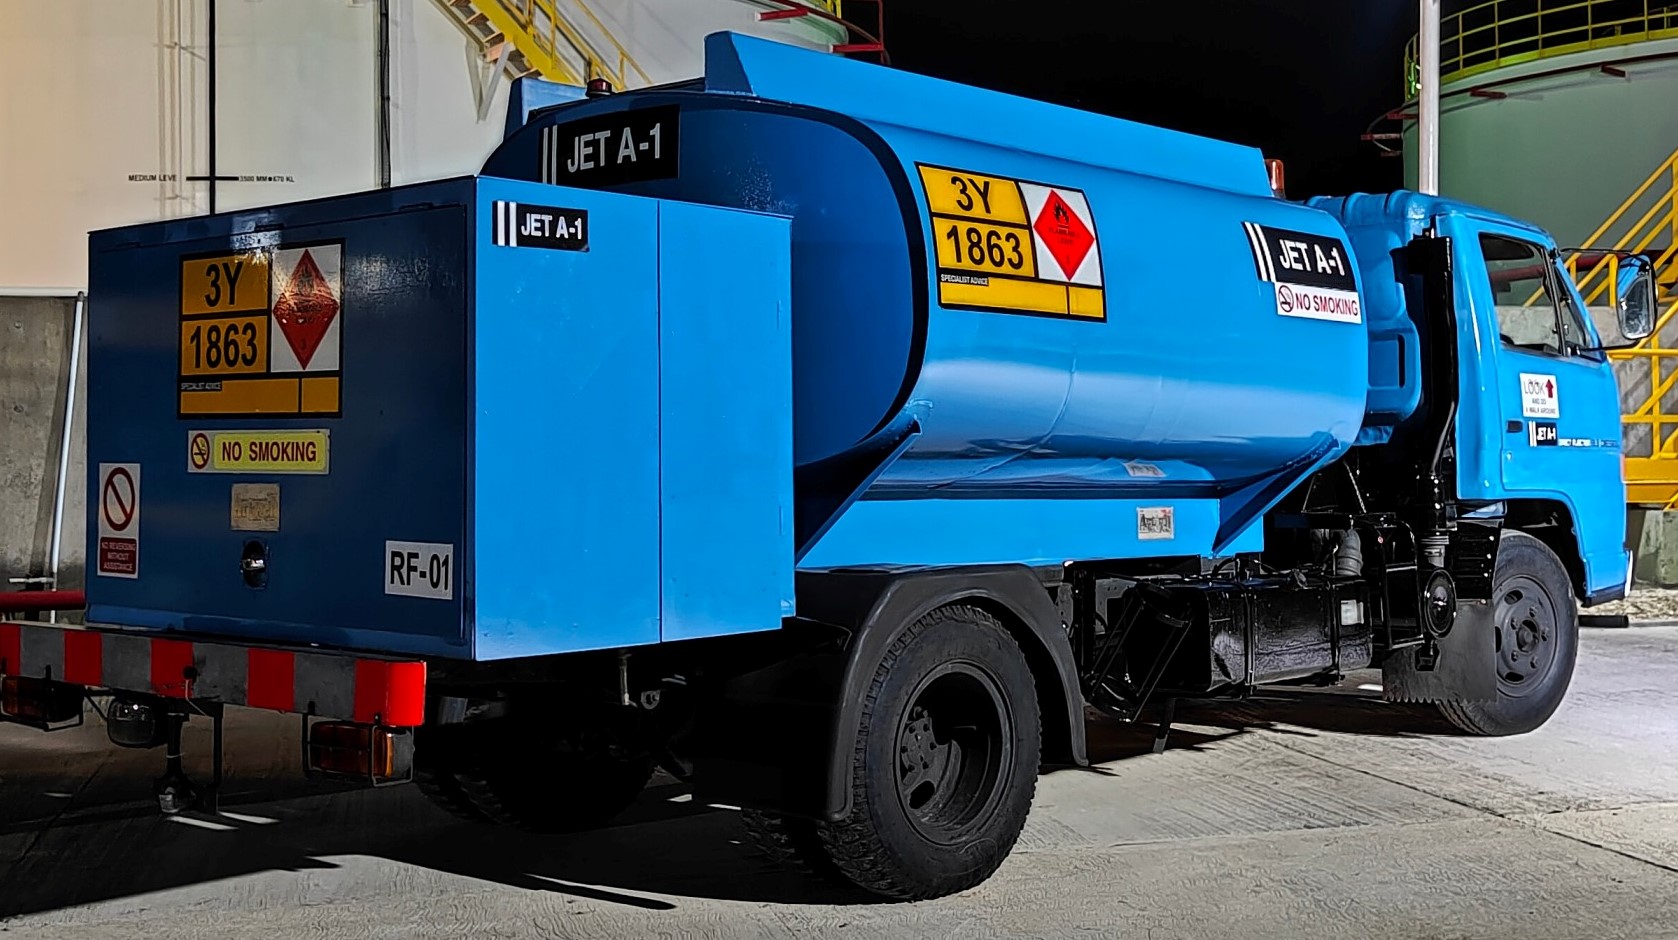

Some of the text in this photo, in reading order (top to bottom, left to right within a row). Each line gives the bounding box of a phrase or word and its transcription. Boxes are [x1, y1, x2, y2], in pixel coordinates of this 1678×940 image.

[567, 122, 661, 173] JET A-1
[128, 174, 157, 182] MEDIUM
[950, 176, 992, 215] 3Y
[520, 213, 583, 240] JET A-1
[946, 225, 1024, 270] 1863
[1279, 239, 1345, 276] JET A-1
[204, 261, 244, 308] 3Y
[940, 274, 988, 285] SPECIALIST ADVICE
[1295, 293, 1358, 316] NO SMOKING
[190, 322, 258, 369] 1863
[1524, 380, 1545, 395] LOOK
[222, 441, 316, 462] NO SMOKING
[390, 550, 449, 591] RF-01
